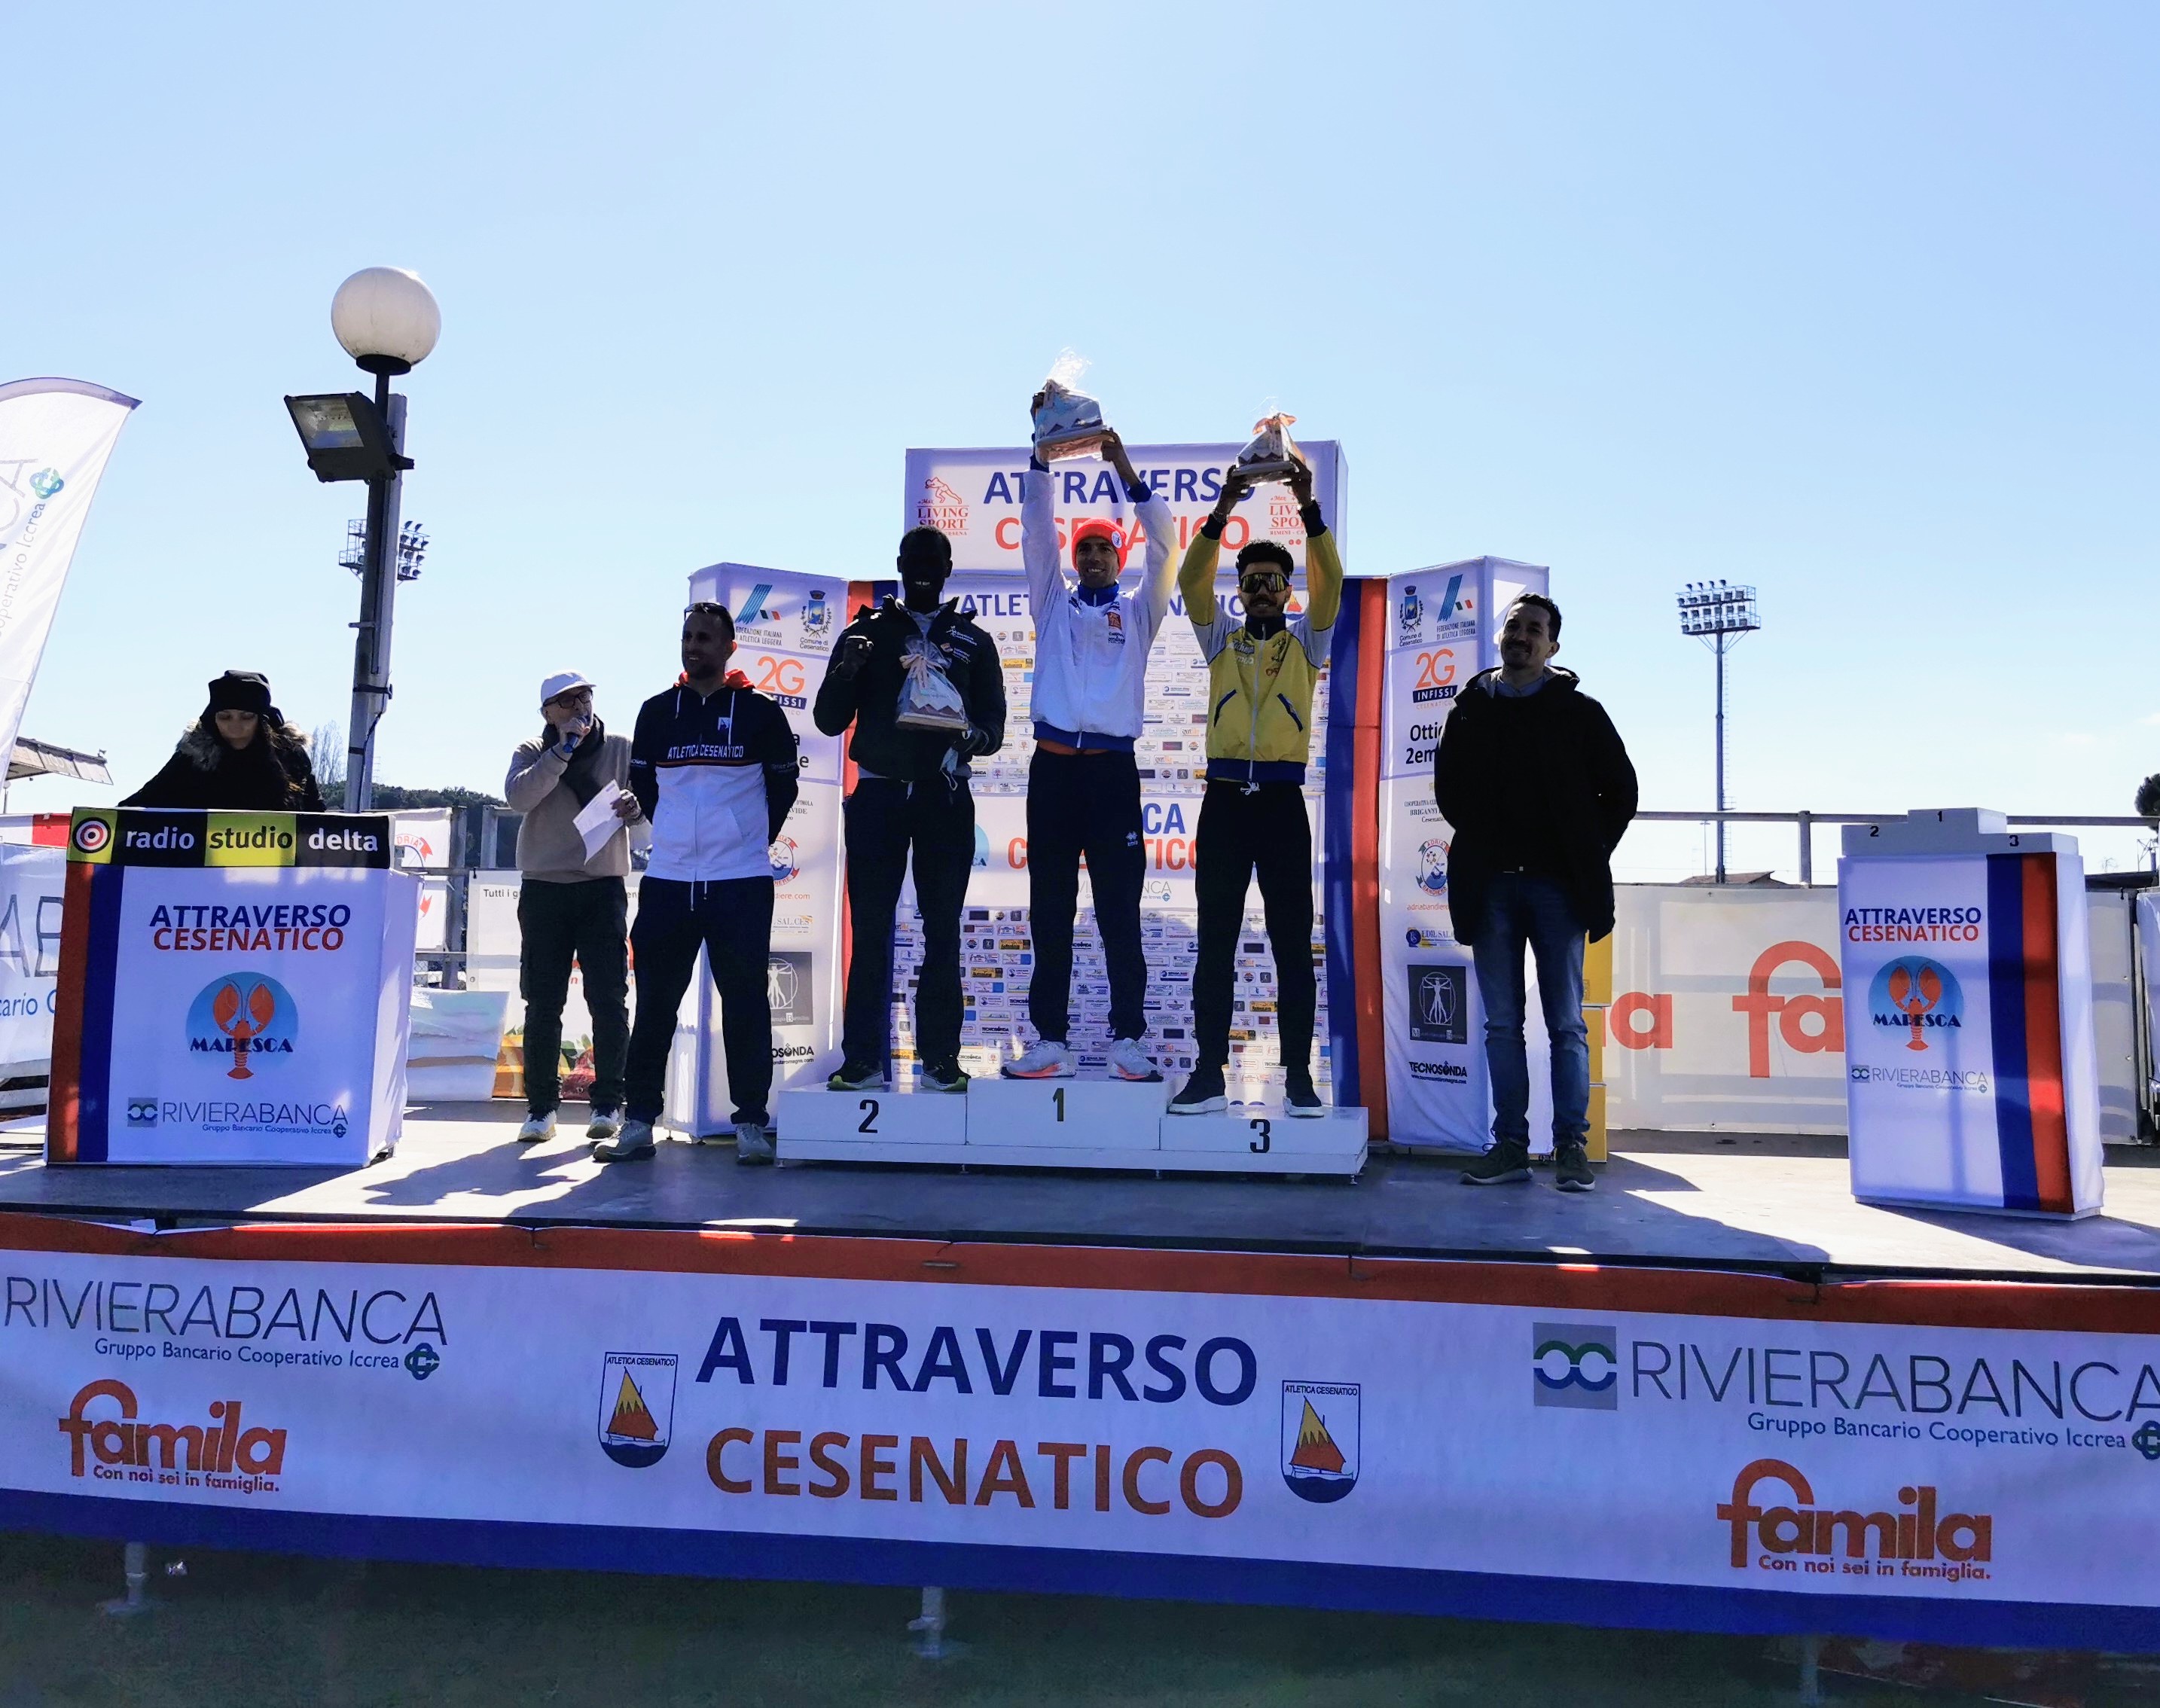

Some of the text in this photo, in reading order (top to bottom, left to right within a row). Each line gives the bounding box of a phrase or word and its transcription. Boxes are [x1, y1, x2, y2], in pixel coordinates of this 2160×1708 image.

[918, 508, 969, 518] LIVING
[799, 642, 829, 652] Cesenatico
[800, 637, 822, 645] Comune
[756, 656, 805, 695] 2G
[1414, 648, 1455, 688] 2G
[1417, 687, 1454, 700] INFISSI
[667, 744, 743, 760] ATLETICA CESENATICO
[1937, 810, 1943, 822] 1
[125, 826, 378, 852] radio studio delta
[1869, 825, 1879, 837] 2
[2009, 834, 2019, 847] 3
[484, 889, 505, 898] Tutti
[149, 904, 352, 928] ATTRAVERSO
[1845, 907, 1982, 925] ATTRAVERSO
[153, 927, 344, 951] CESENATICO
[1848, 925, 1979, 942] CESENATICO
[1408, 1061, 1468, 1078] TECNOSONDA
[1872, 1067, 1988, 1085] RIVIERABANCA
[162, 1102, 349, 1126] RIVIERABANCA
[859, 1099, 880, 1133] 2
[1053, 1088, 1065, 1122] 1
[202, 1124, 230, 1133] Gruppo
[264, 1124, 310, 1134] Cooperativo
[1249, 1118, 1271, 1154] 3
[4, 1276, 447, 1346] RIVIERABANCA
[95, 1337, 399, 1369] Gruppo Bancario Cooperativo Iccrea
[607, 1356, 676, 1367] ATLETICA CESENATICO
[695, 1316, 1257, 1407] ATTRAVERSO
[1285, 1385, 1358, 1396] ATLETICA CESENATICO
[59, 1379, 288, 1477] famila
[1747, 1411, 2126, 1450] Gruppo Bancario Cooperativo Iccrea
[93, 1465, 280, 1494] Con noi sei in famiglia.
[705, 1426, 1243, 1518] CESENATICO
[1716, 1458, 1992, 1568] famila
[1759, 1554, 1991, 1583] Con noi sei in famiglia.
